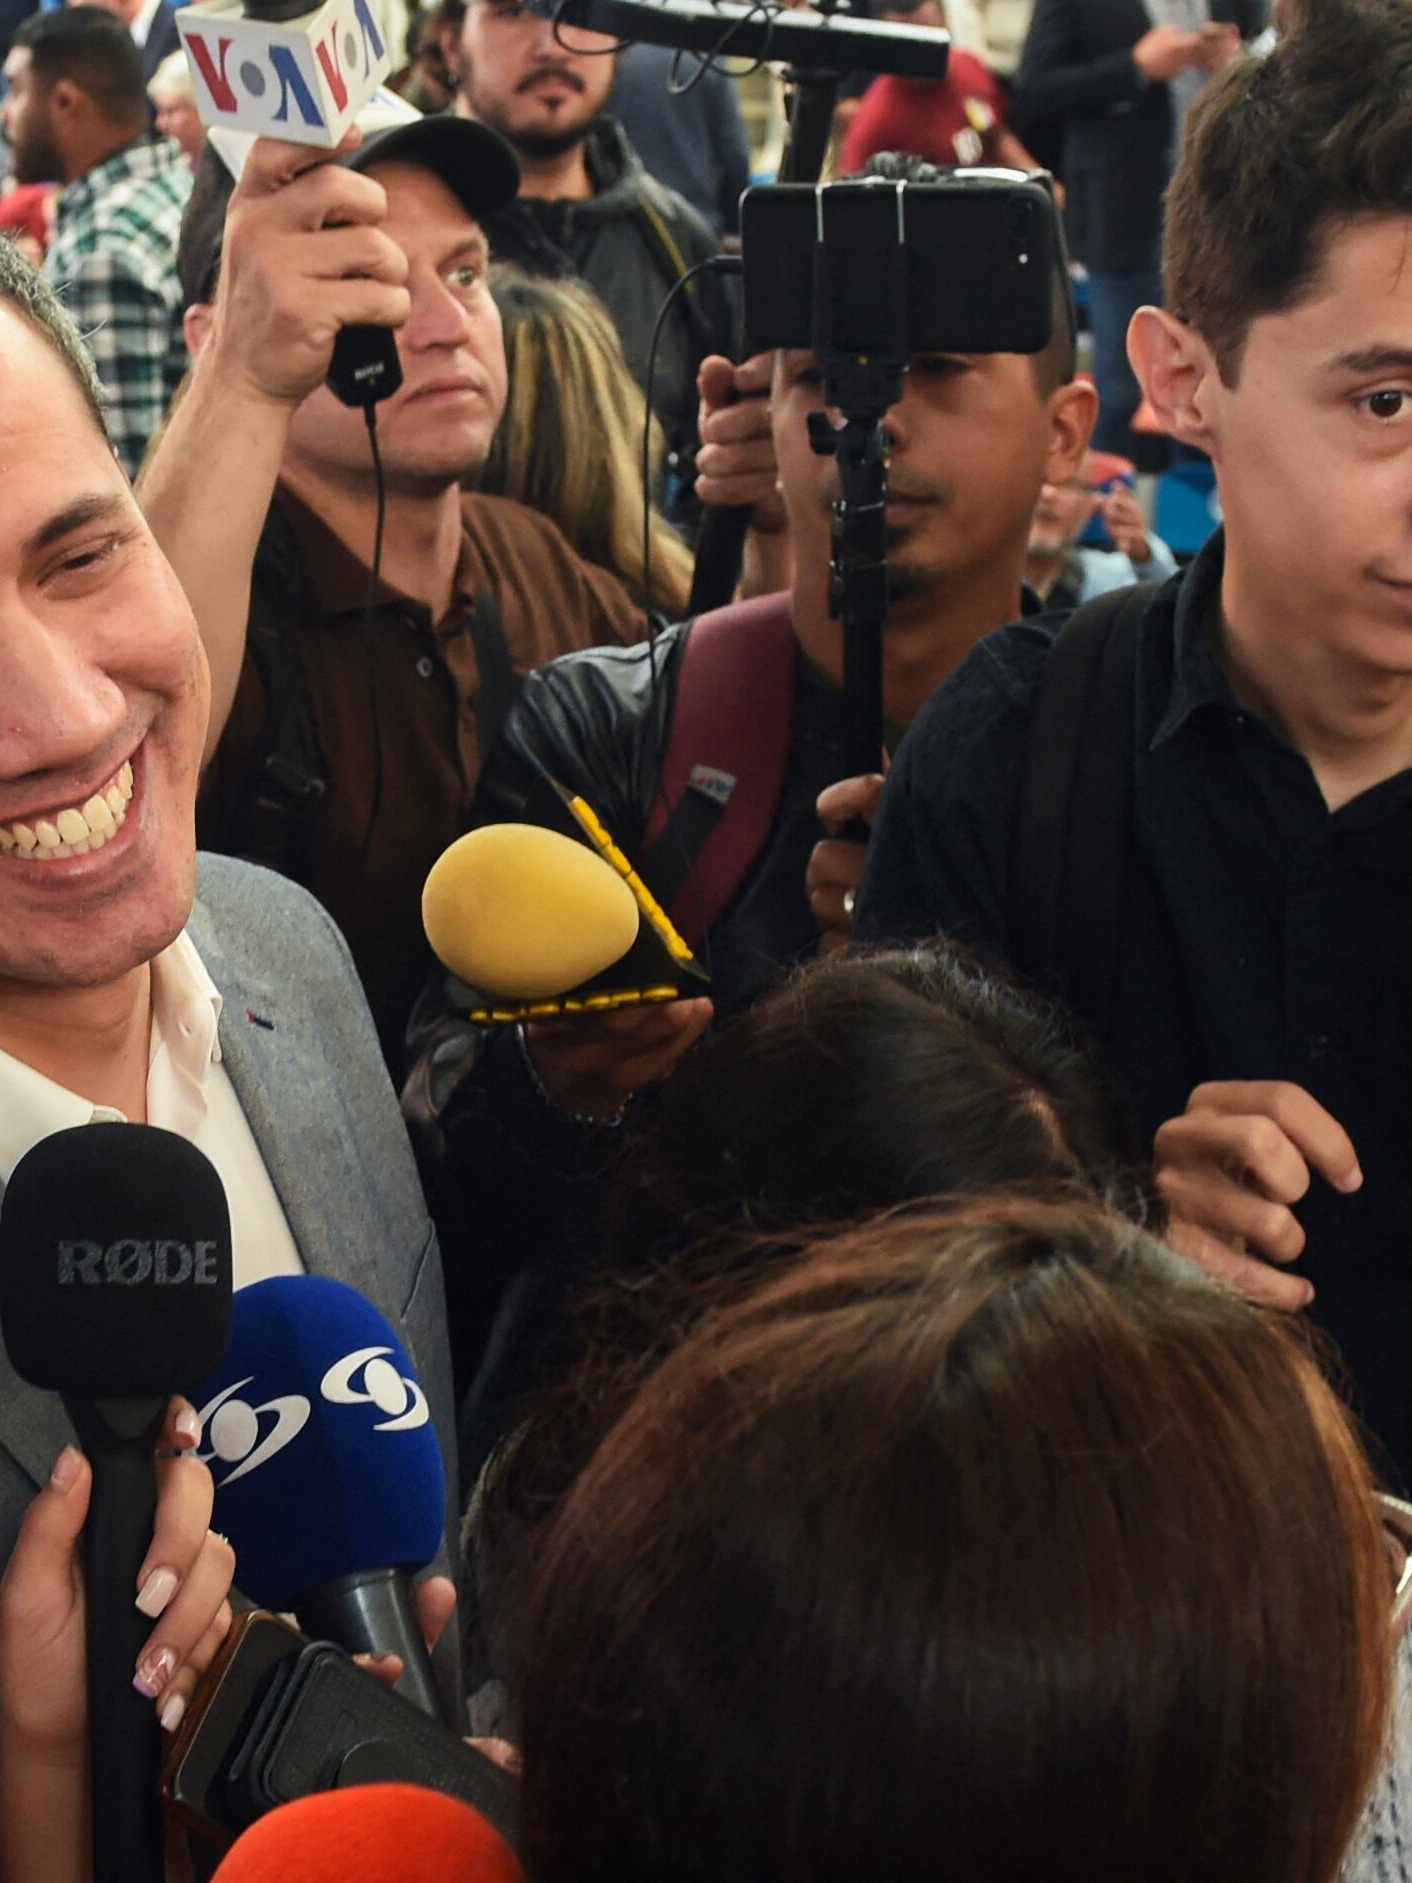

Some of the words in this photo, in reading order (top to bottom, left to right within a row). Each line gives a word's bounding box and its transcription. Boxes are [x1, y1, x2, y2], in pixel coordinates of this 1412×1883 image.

[184, 33, 325, 128] VOA
[315, 0, 385, 114] VOA
[57, 1239, 218, 1285] RØDE
